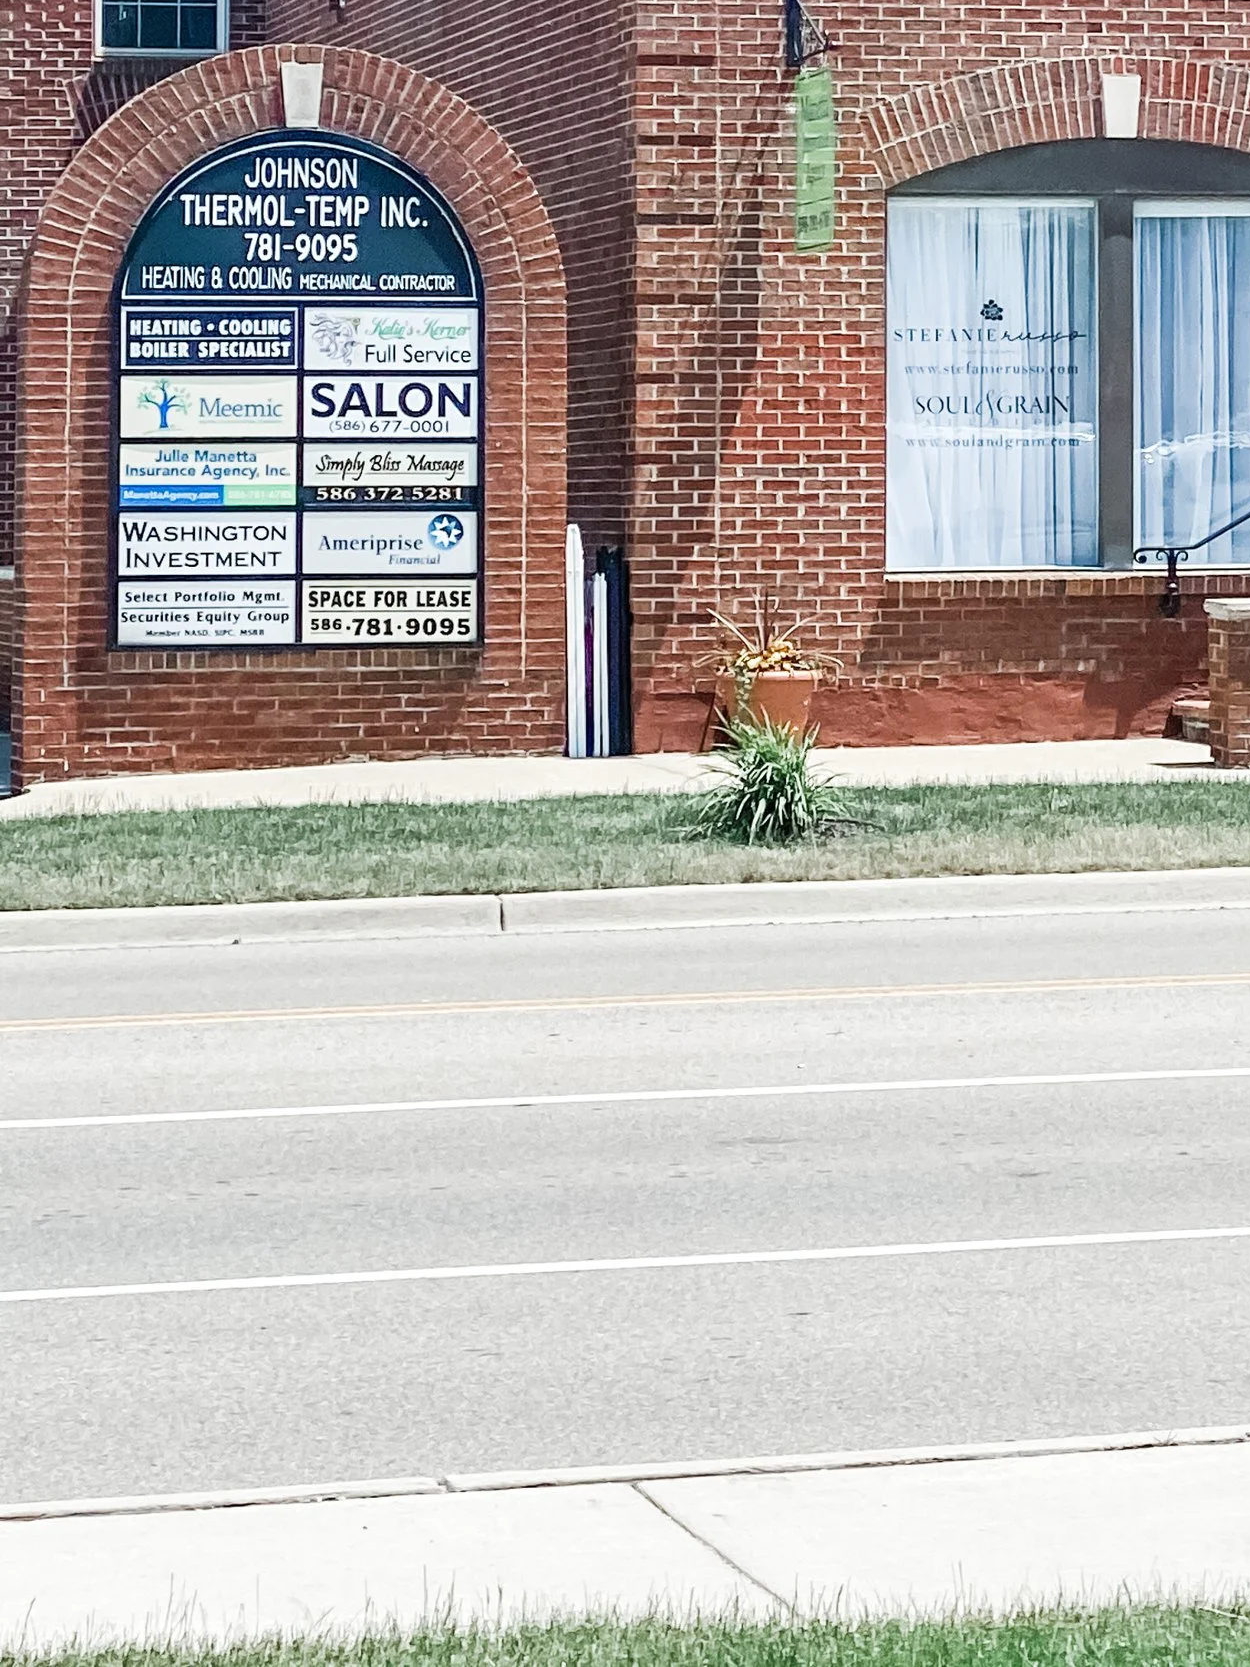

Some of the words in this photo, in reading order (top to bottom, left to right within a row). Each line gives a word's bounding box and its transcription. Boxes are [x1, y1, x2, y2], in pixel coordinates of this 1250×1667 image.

[244, 157, 358, 189] JOHNSON
[180, 194, 369, 228] THERMOL-TEMP
[380, 196, 428, 228] INC.
[244, 233, 358, 262] 781-9095
[142, 266, 204, 289] HEATING
[211, 268, 222, 289] &
[228, 267, 292, 290] COOLING
[299, 274, 376, 291] MECHANICAL
[379, 274, 456, 291] CONTRACTOR
[130, 319, 201, 336] HEATING
[218, 319, 291, 336] COOLING
[365, 317, 414, 340] Katie's
[894, 328, 997, 342] STEFANIE
[130, 342, 189, 358] BOILER
[198, 342, 291, 358] SPECIALIST
[365, 344, 396, 363] Full
[403, 344, 471, 363] Service
[198, 397, 283, 417] Meemic
[311, 382, 471, 417] SALON
[329, 421, 365, 433] (586)
[370, 421, 449, 433] 677-0001
[155, 450, 188, 462] Julie
[194, 450, 257, 462] Manetta
[126, 464, 196, 476] Insurance
[201, 464, 260, 479] Agency,
[265, 464, 290, 476] Inc.
[316, 451, 365, 481] Simply
[370, 451, 401, 471] Bliss
[406, 454, 464, 481] Massage
[316, 487, 356, 500] 586
[363, 487, 403, 500] 372
[412, 487, 462, 501] 5281
[318, 535, 423, 555] Ameriprise
[389, 554, 441, 565] Financial
[125, 592, 167, 602] Select
[175, 592, 235, 602] Portfolio
[308, 591, 366, 607] SPACE
[374, 591, 407, 607] FOR
[416, 591, 471, 607] LEASE
[121, 612, 190, 622] Securities
[197, 612, 240, 624] Equity
[248, 612, 289, 624] Group
